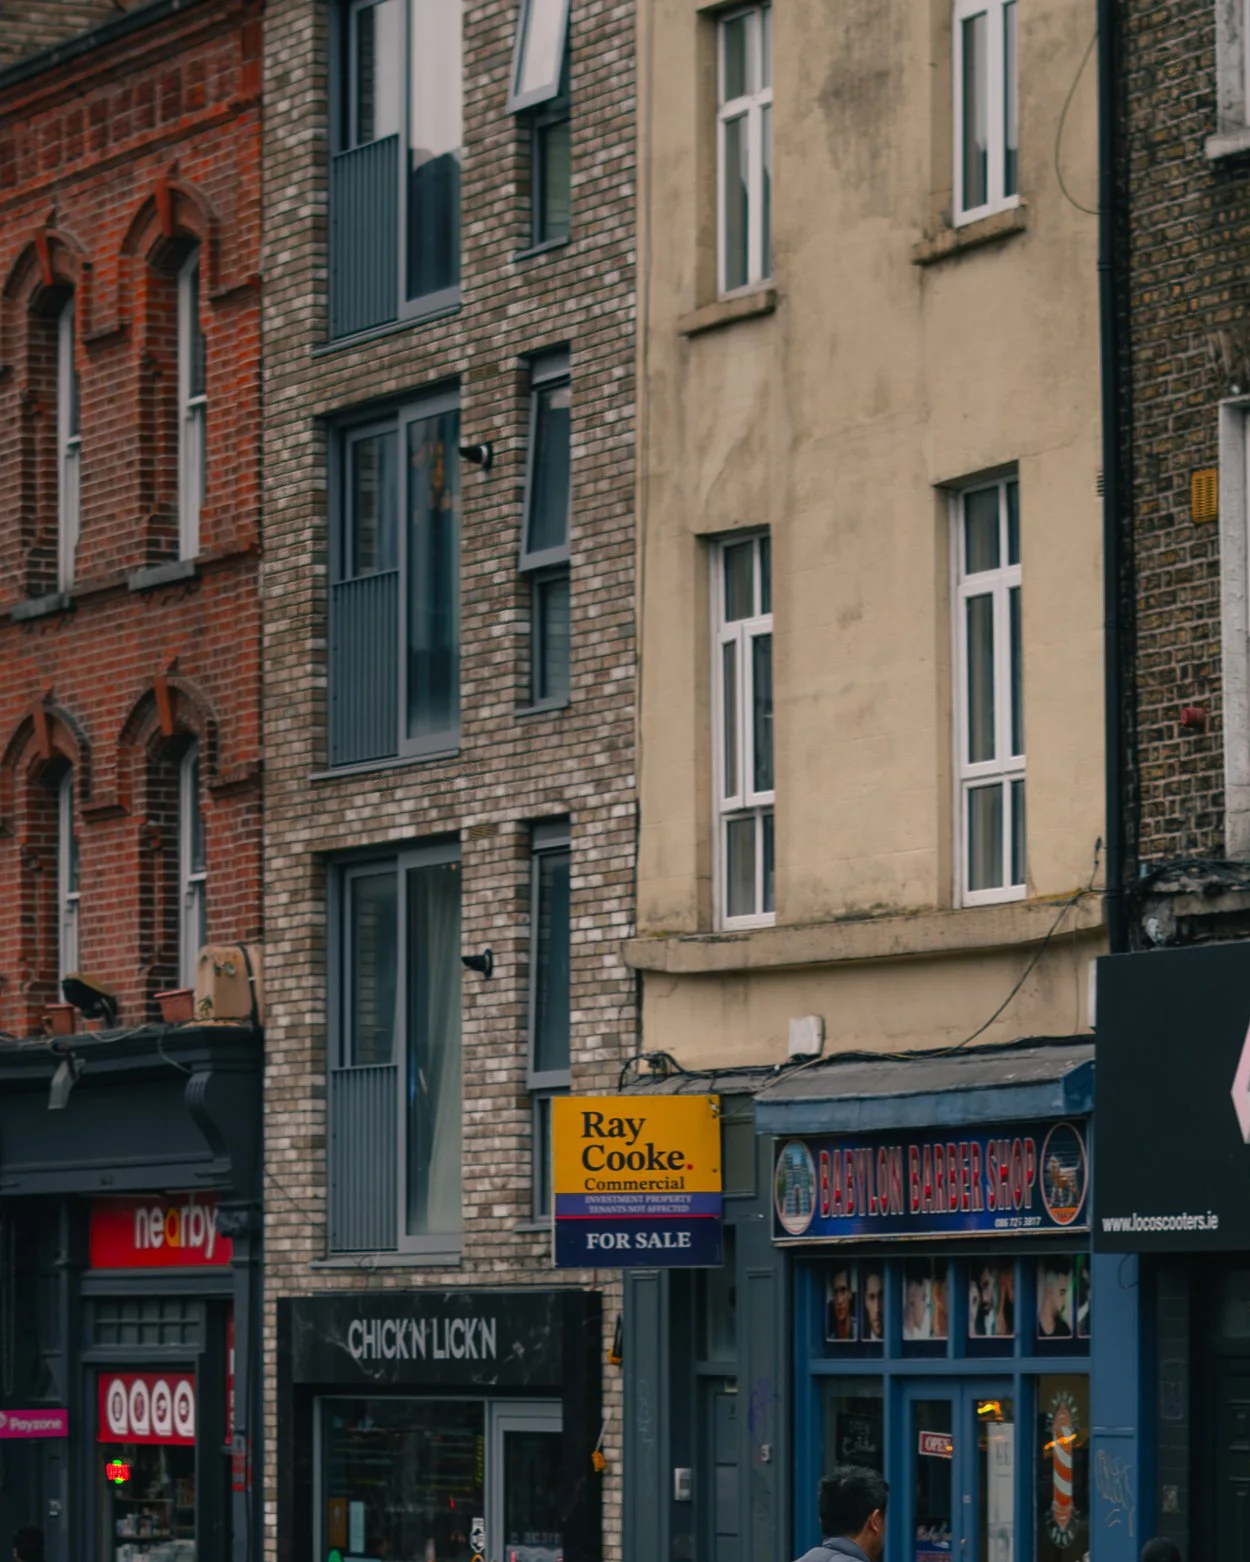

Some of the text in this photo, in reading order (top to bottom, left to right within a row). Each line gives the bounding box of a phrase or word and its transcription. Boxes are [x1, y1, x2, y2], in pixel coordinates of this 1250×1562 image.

[580, 1111, 647, 1146] Ray
[584, 1176, 685, 1191] Commercial
[818, 1136, 1037, 1219] BABYLON BARBER SHOP
[584, 1194, 693, 1204] INVESTMENT PROPERTY
[134, 1193, 219, 1260] nearby
[1101, 1210, 1219, 1232] www.locoscooters.ie
[585, 1231, 692, 1249] FOR SALE
[347, 1317, 497, 1360] CHICK'N LICK'N
[9, 1417, 63, 1432] Payzone
